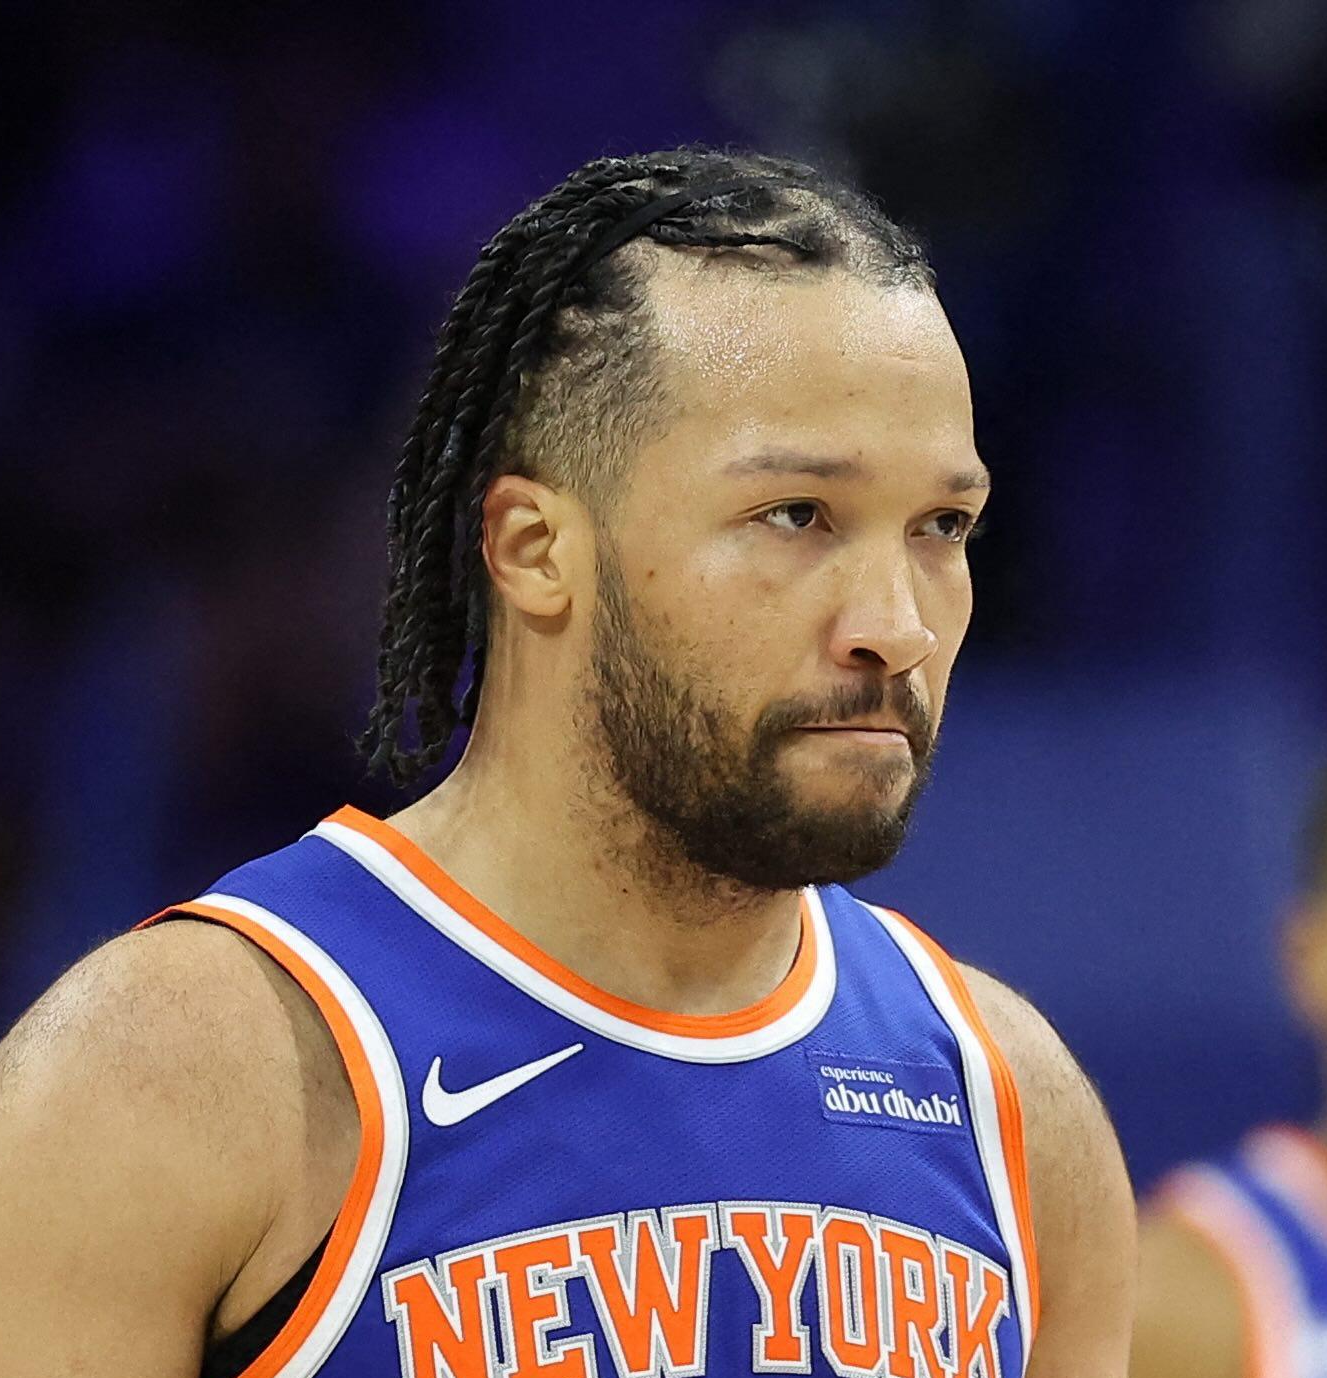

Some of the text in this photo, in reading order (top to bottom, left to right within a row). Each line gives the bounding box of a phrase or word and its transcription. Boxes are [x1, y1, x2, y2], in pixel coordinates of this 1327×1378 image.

[820, 1065, 894, 1084] experience
[826, 1083, 962, 1126] abu dhabi
